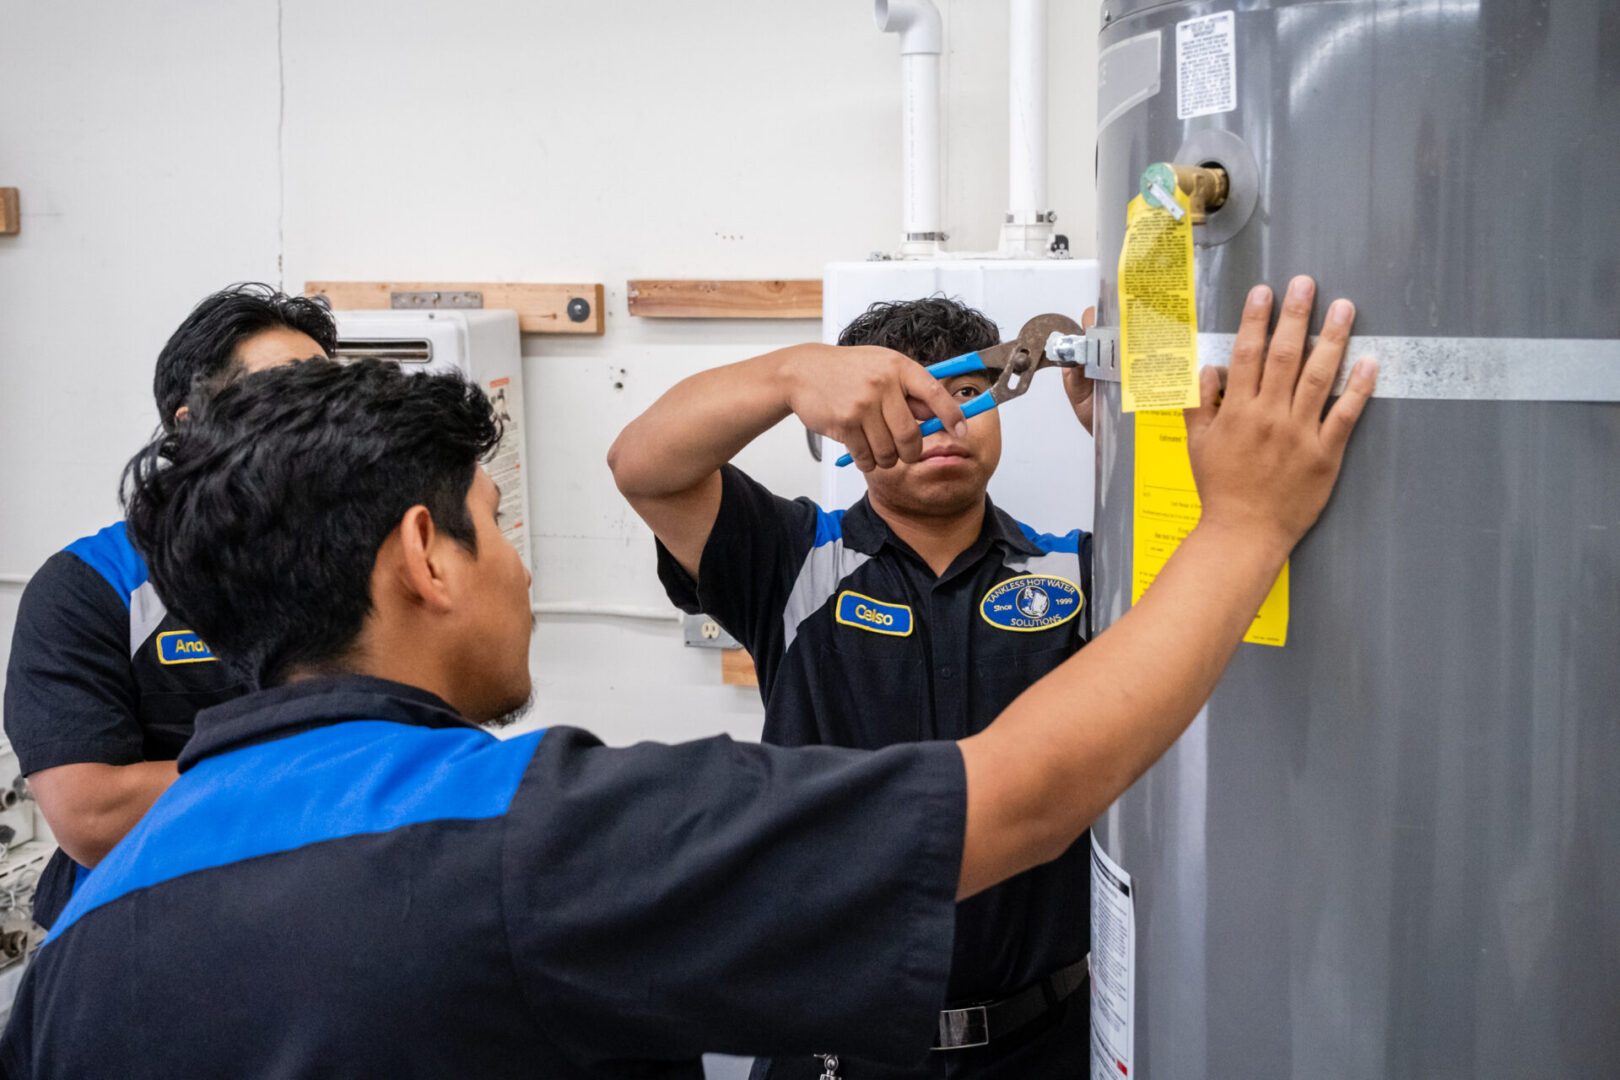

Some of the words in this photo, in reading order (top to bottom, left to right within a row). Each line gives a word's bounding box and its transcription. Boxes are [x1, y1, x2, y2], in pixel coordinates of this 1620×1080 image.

[986, 581, 1025, 603] TANKLESS
[1027, 578, 1046, 587] HOT
[1047, 579, 1075, 595] WATER
[993, 604, 1012, 612] Since
[1055, 598, 1073, 606] 1999
[855, 603, 894, 626] Celso
[1010, 614, 1062, 627] SOLUTIONS
